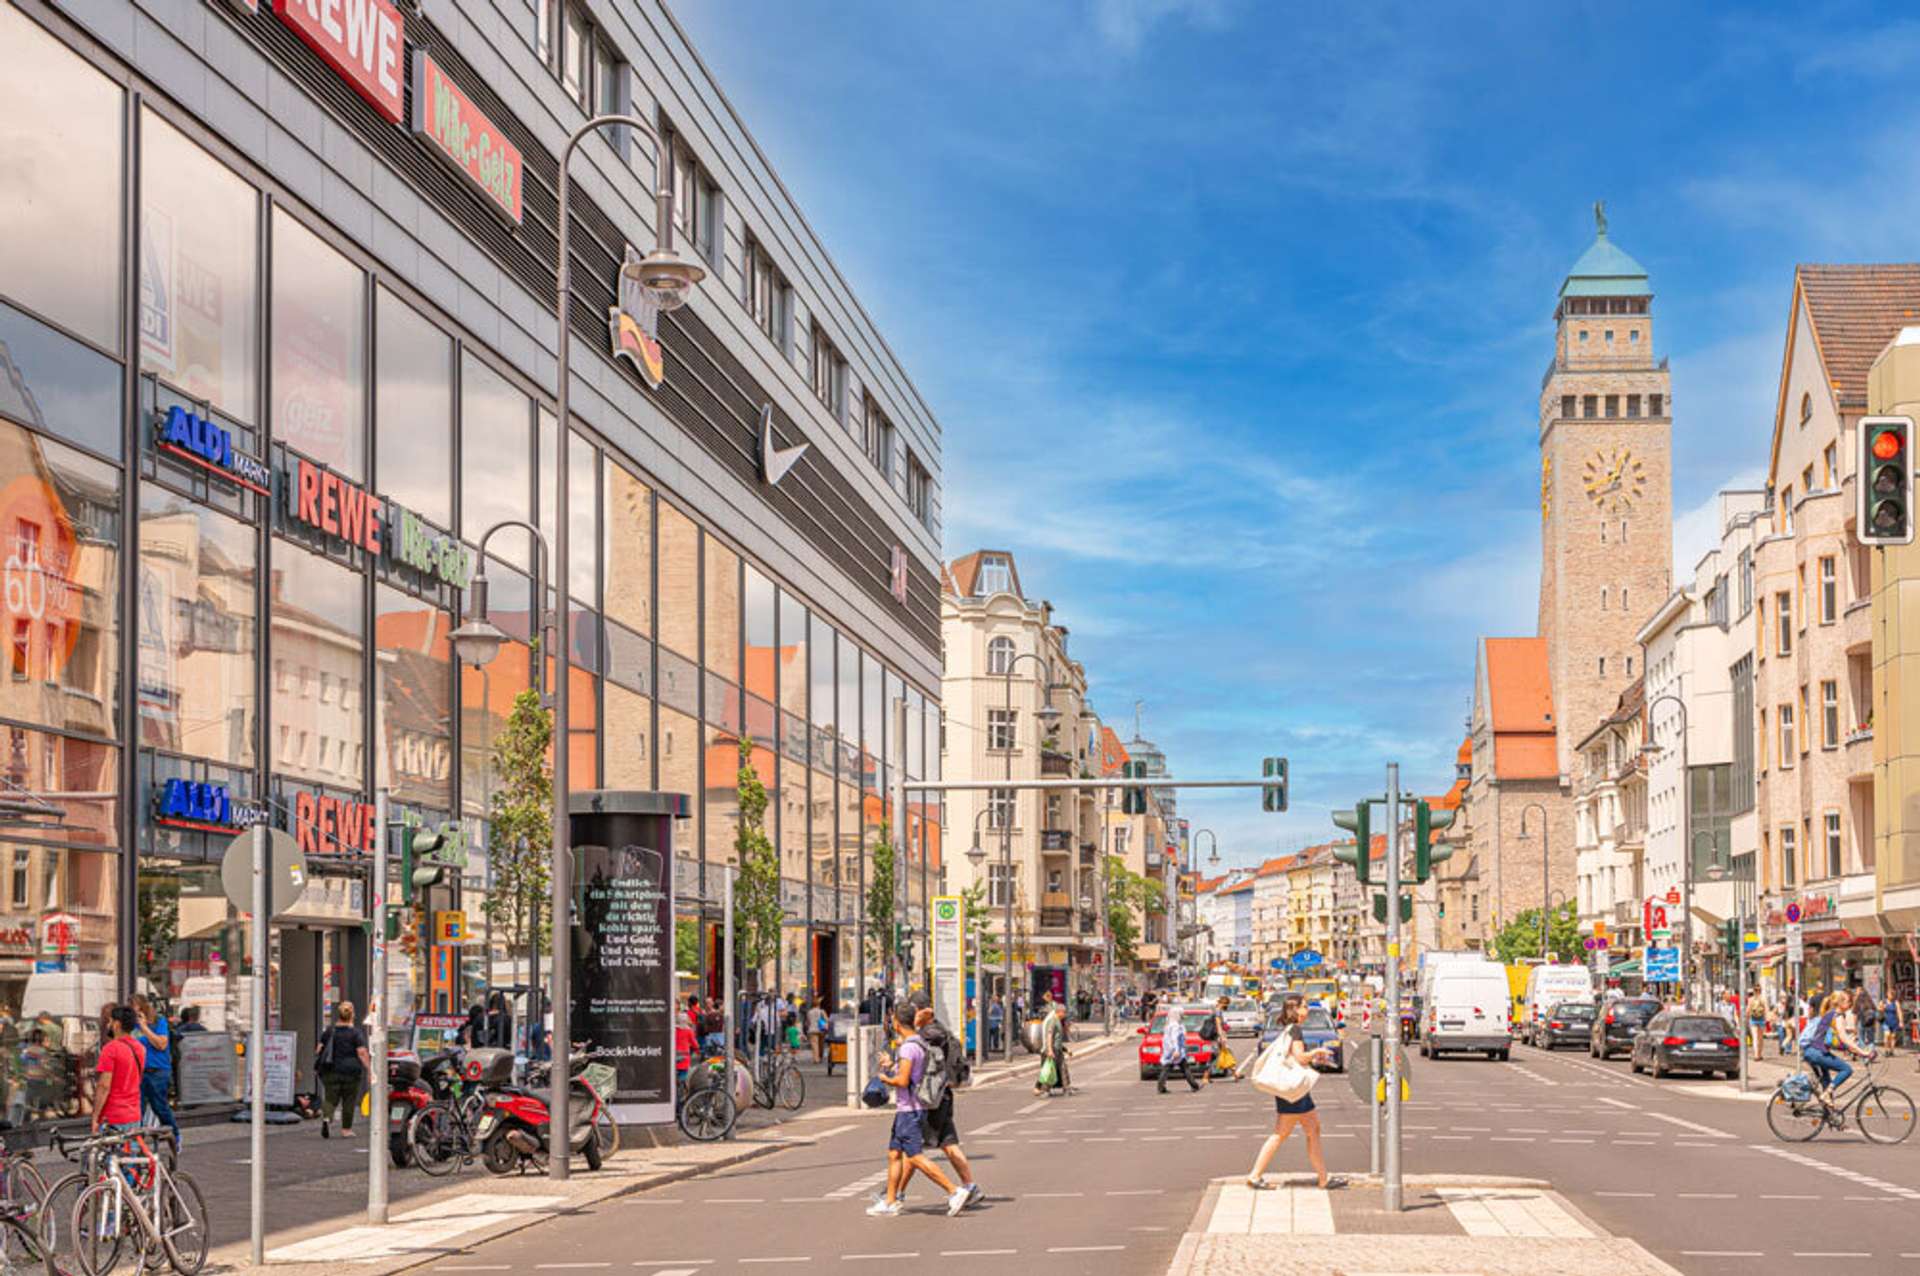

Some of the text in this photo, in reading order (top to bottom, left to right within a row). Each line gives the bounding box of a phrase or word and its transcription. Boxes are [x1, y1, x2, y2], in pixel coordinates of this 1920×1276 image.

[302, 0, 398, 98] EWE
[164, 405, 270, 487] ALDI MARKT
[299, 458, 381, 554] REWE
[160, 779, 230, 823] ALDI
[611, 879, 650, 888] Endlich
[610, 901, 652, 910] mit dem
[445, 923, 460, 937] EC
[606, 934, 627, 944] Und
[600, 946, 621, 955] Und
[600, 957, 621, 967] Und
